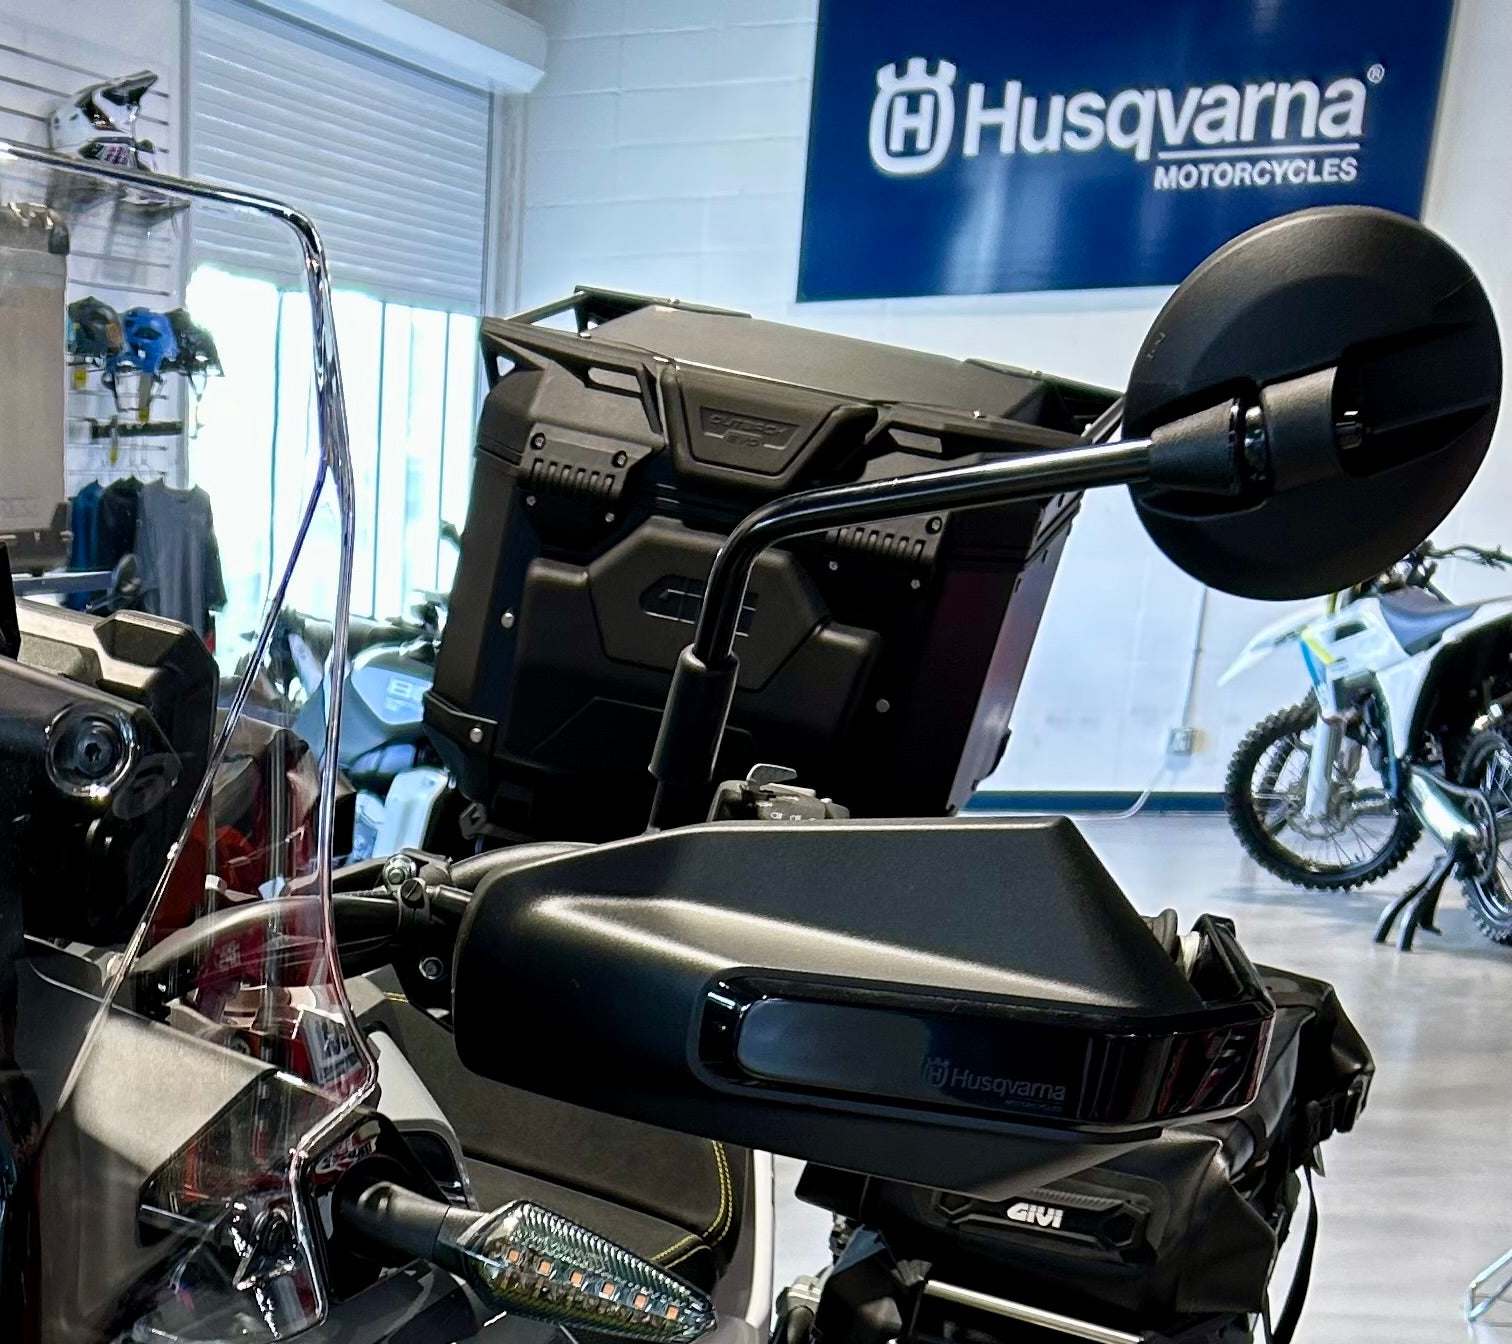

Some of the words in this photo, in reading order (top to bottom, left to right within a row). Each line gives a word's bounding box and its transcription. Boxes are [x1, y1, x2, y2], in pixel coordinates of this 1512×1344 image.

[1154, 158, 1358, 190] MOTORCYCLES
[950, 1067, 1067, 1102] Husqvarna
[1006, 1202, 1064, 1229] GIVI
